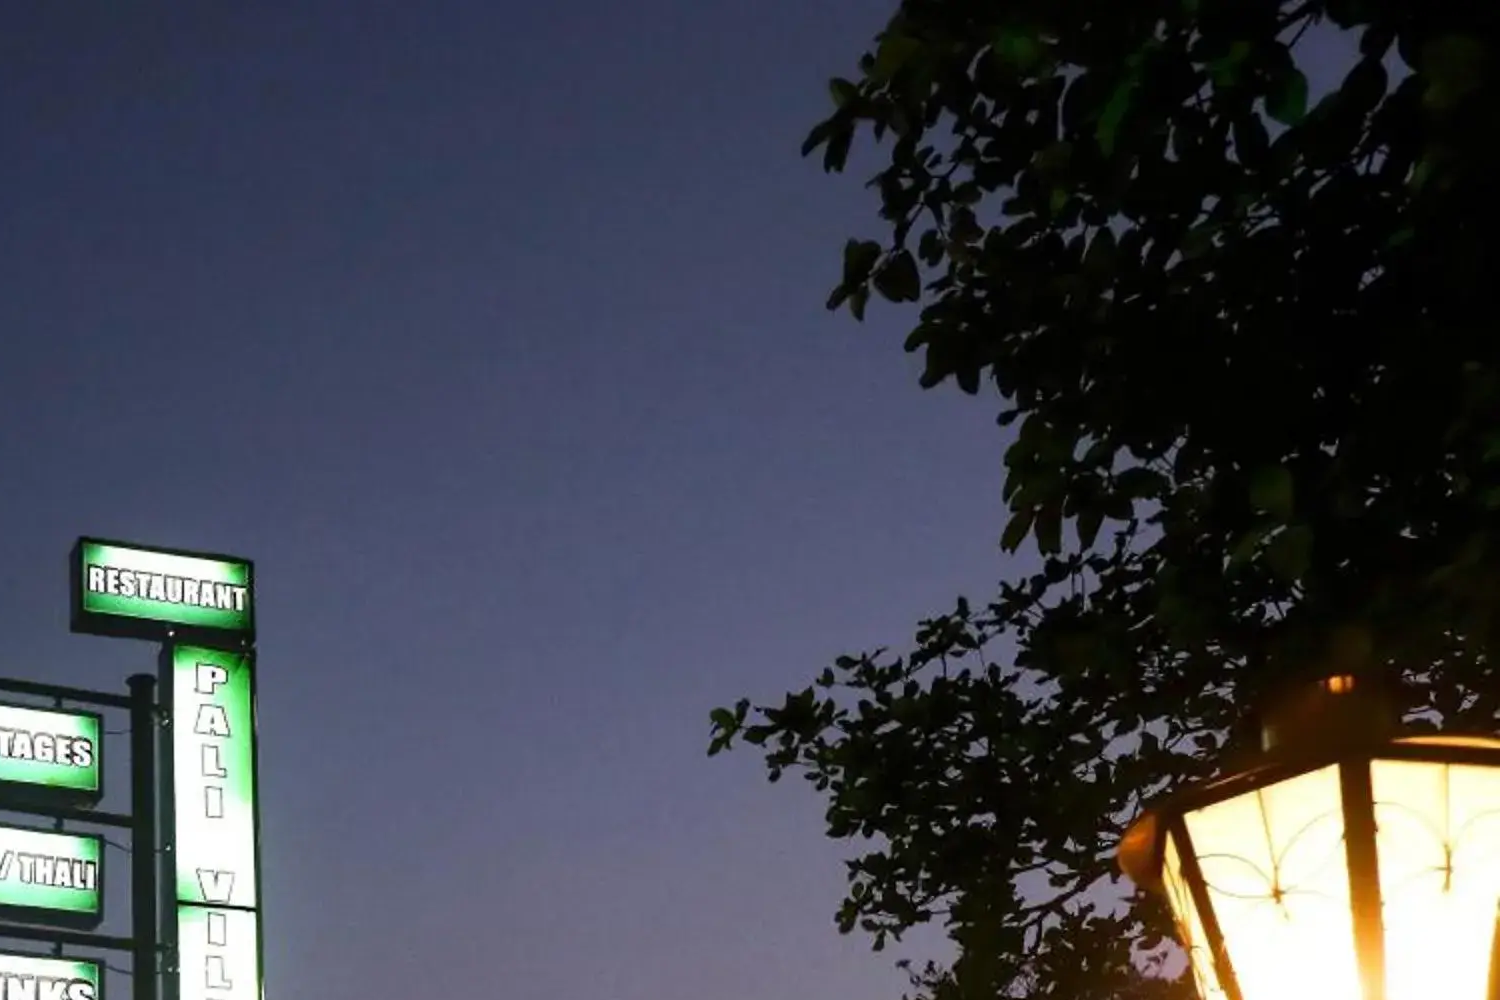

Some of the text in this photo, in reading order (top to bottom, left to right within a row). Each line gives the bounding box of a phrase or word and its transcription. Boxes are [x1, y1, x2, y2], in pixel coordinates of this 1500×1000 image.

[88, 564, 248, 612] RESTAURANT
[194, 662, 231, 819] PALI
[20, 853, 97, 891] THALI
